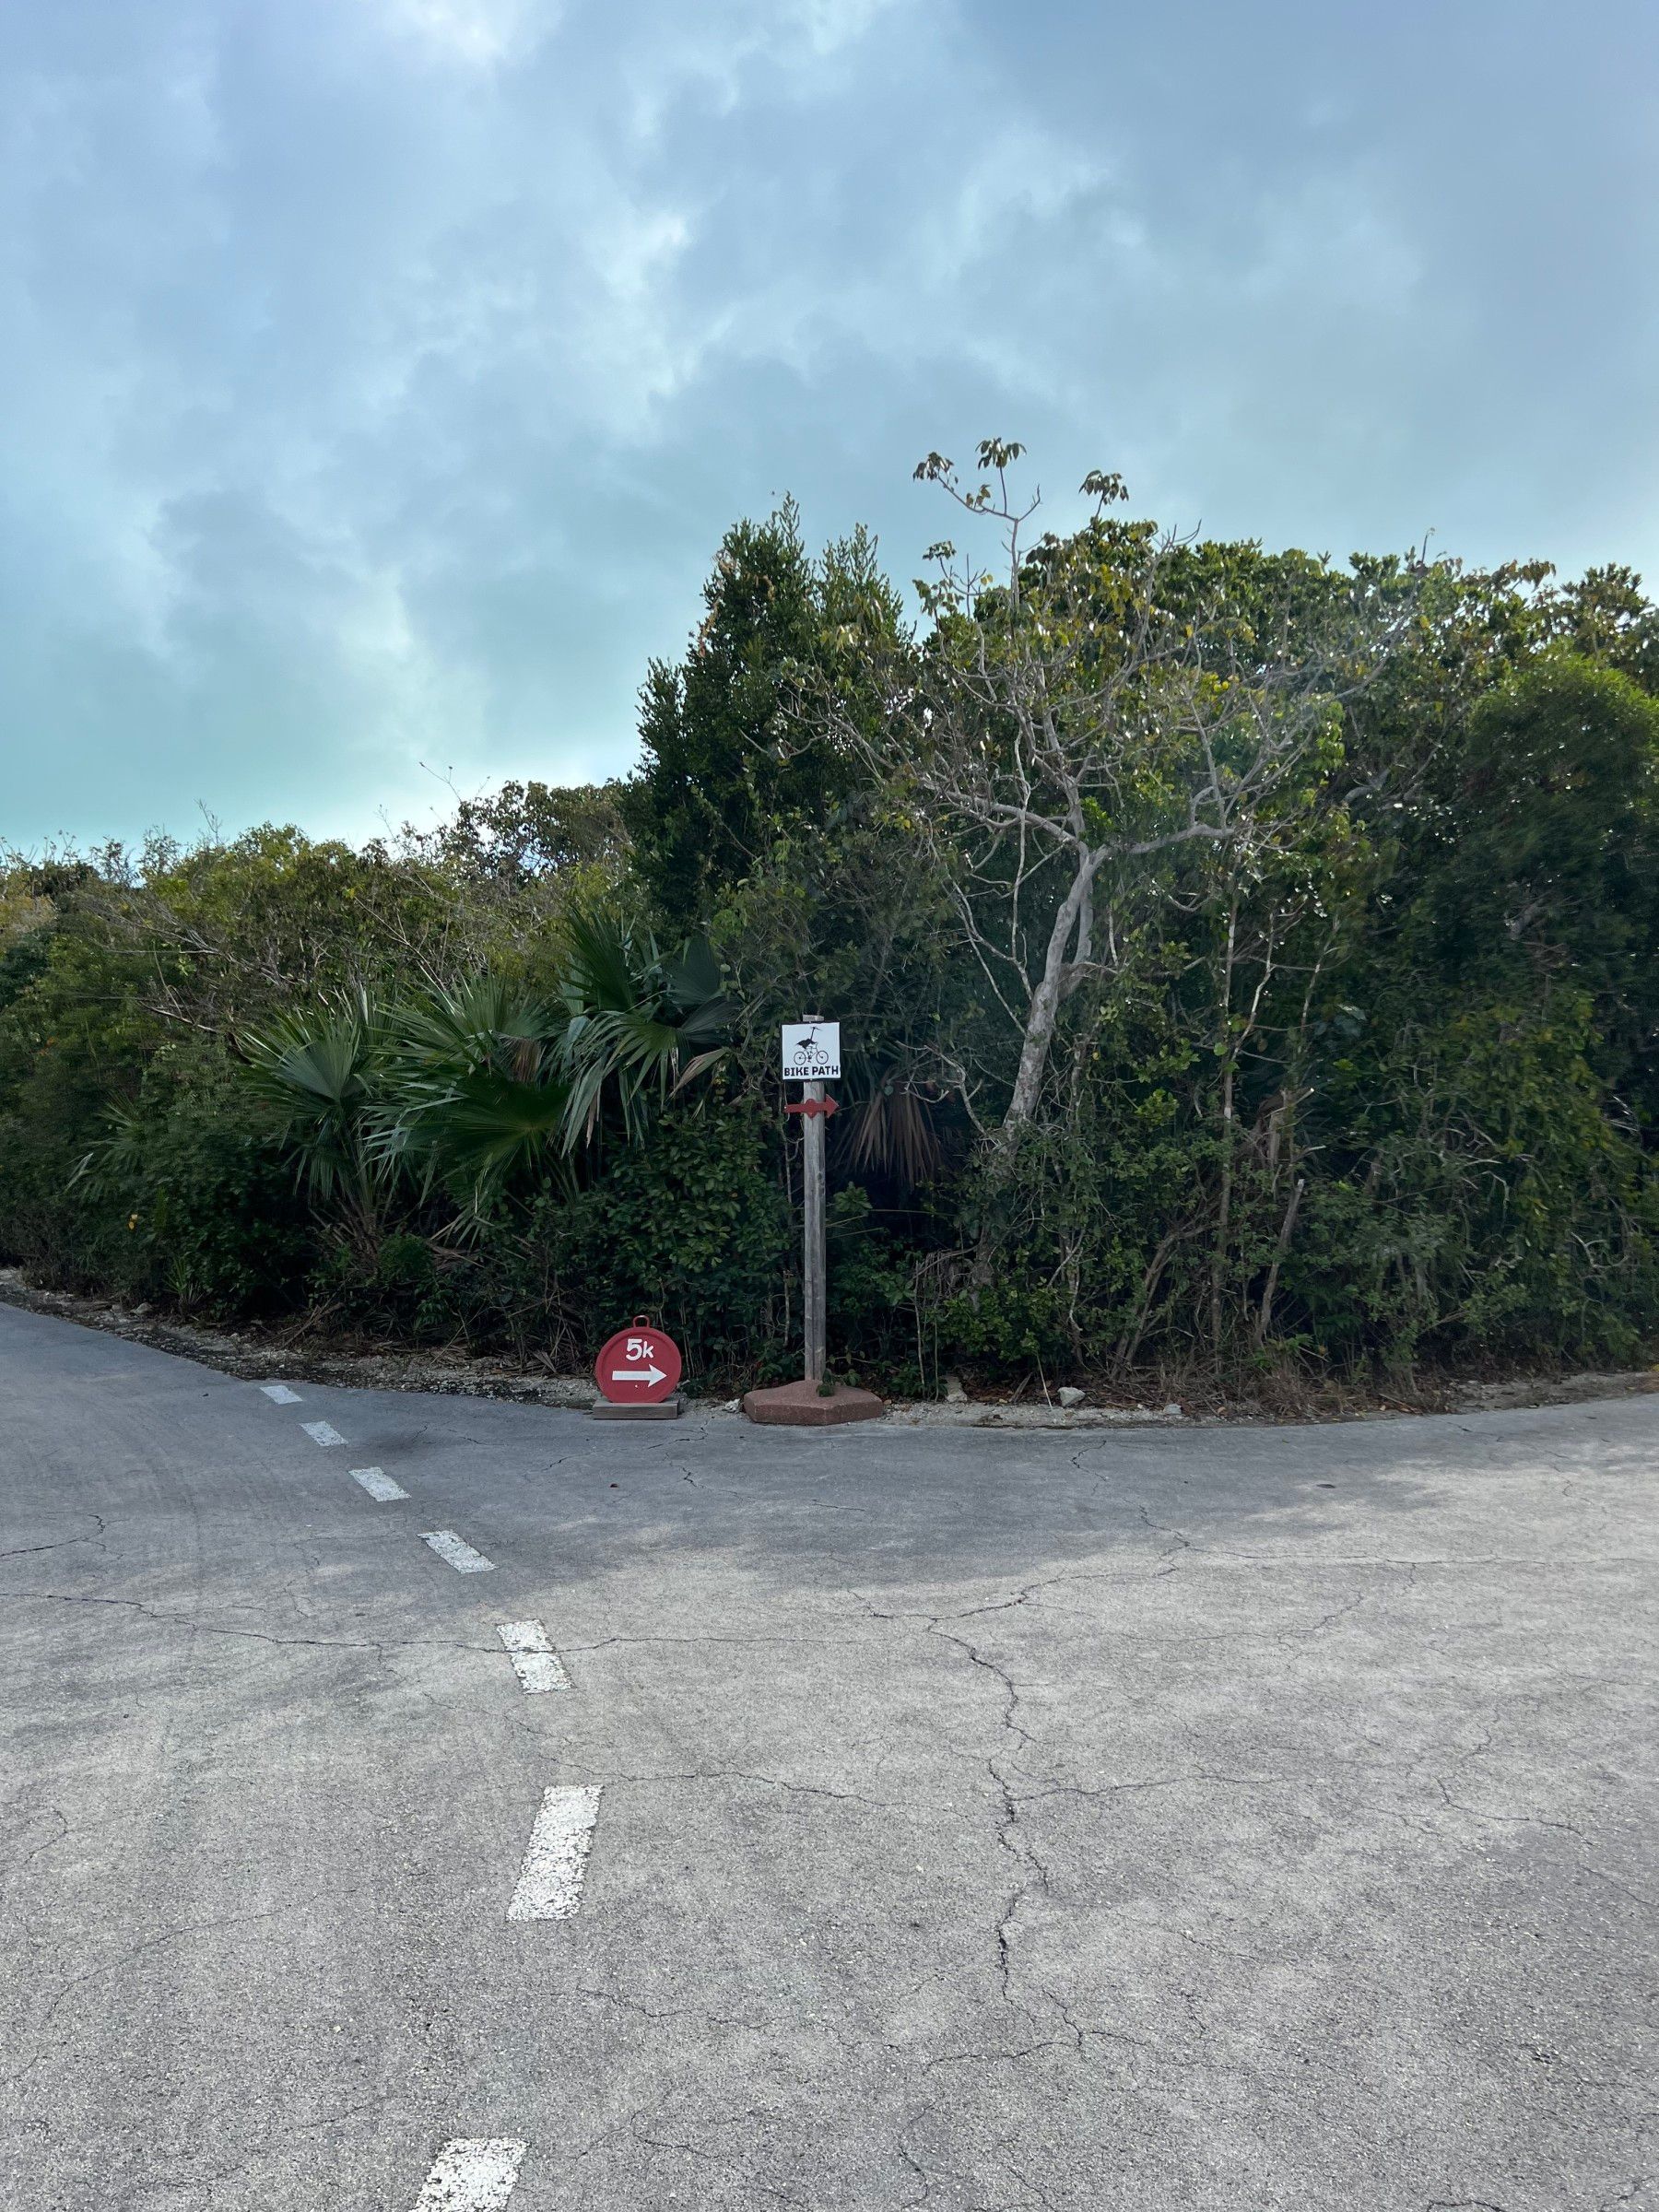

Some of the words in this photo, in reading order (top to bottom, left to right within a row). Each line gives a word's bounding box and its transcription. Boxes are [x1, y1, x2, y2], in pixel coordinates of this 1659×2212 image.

[783, 1066, 809, 1077] BIKE
[812, 1065, 839, 1076] PATH
[625, 1338, 654, 1361] 5k
